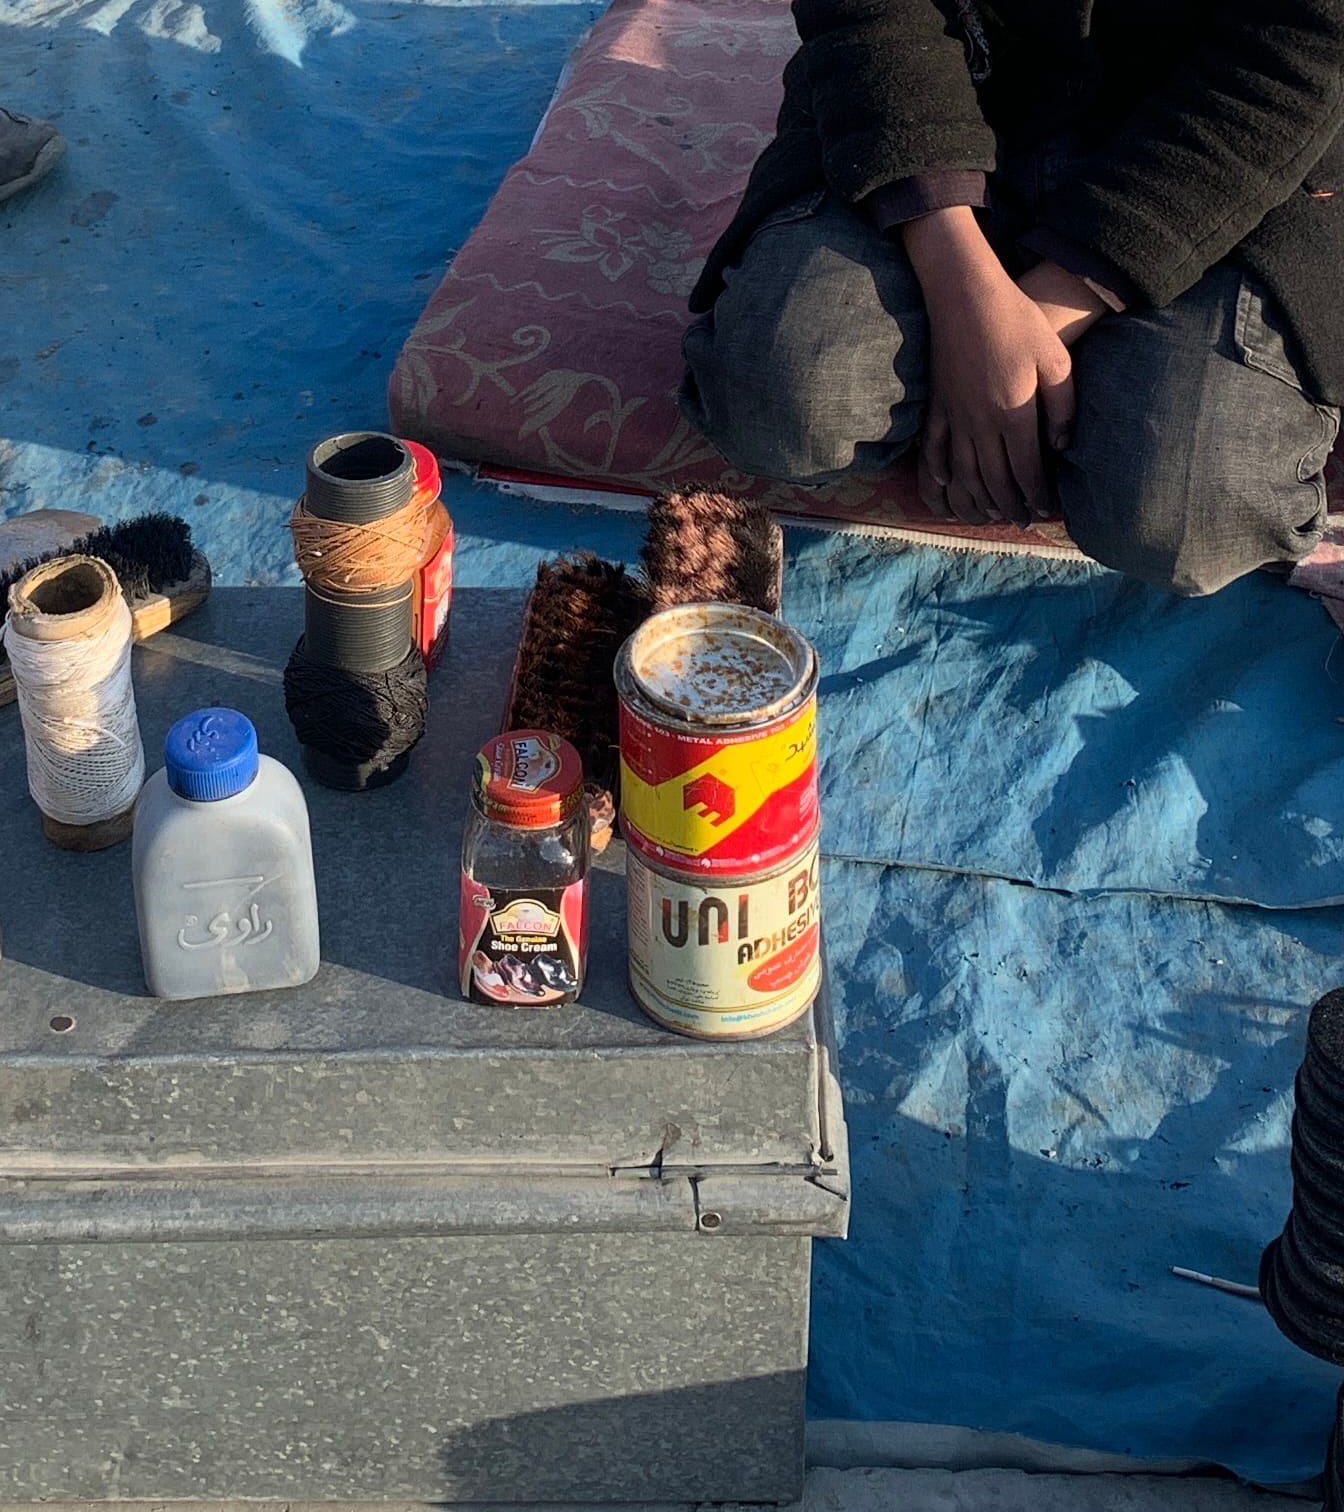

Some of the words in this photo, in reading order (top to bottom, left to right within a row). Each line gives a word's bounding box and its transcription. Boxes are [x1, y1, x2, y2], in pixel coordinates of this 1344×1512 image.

[677, 734, 714, 746] METAL
[716, 731, 768, 745] ADHESIVE
[514, 741, 529, 787] FALCON
[499, 920, 552, 931] FALCON
[501, 934, 515, 942] The
[491, 939, 519, 952] Shoe
[521, 942, 558, 953] Cream
